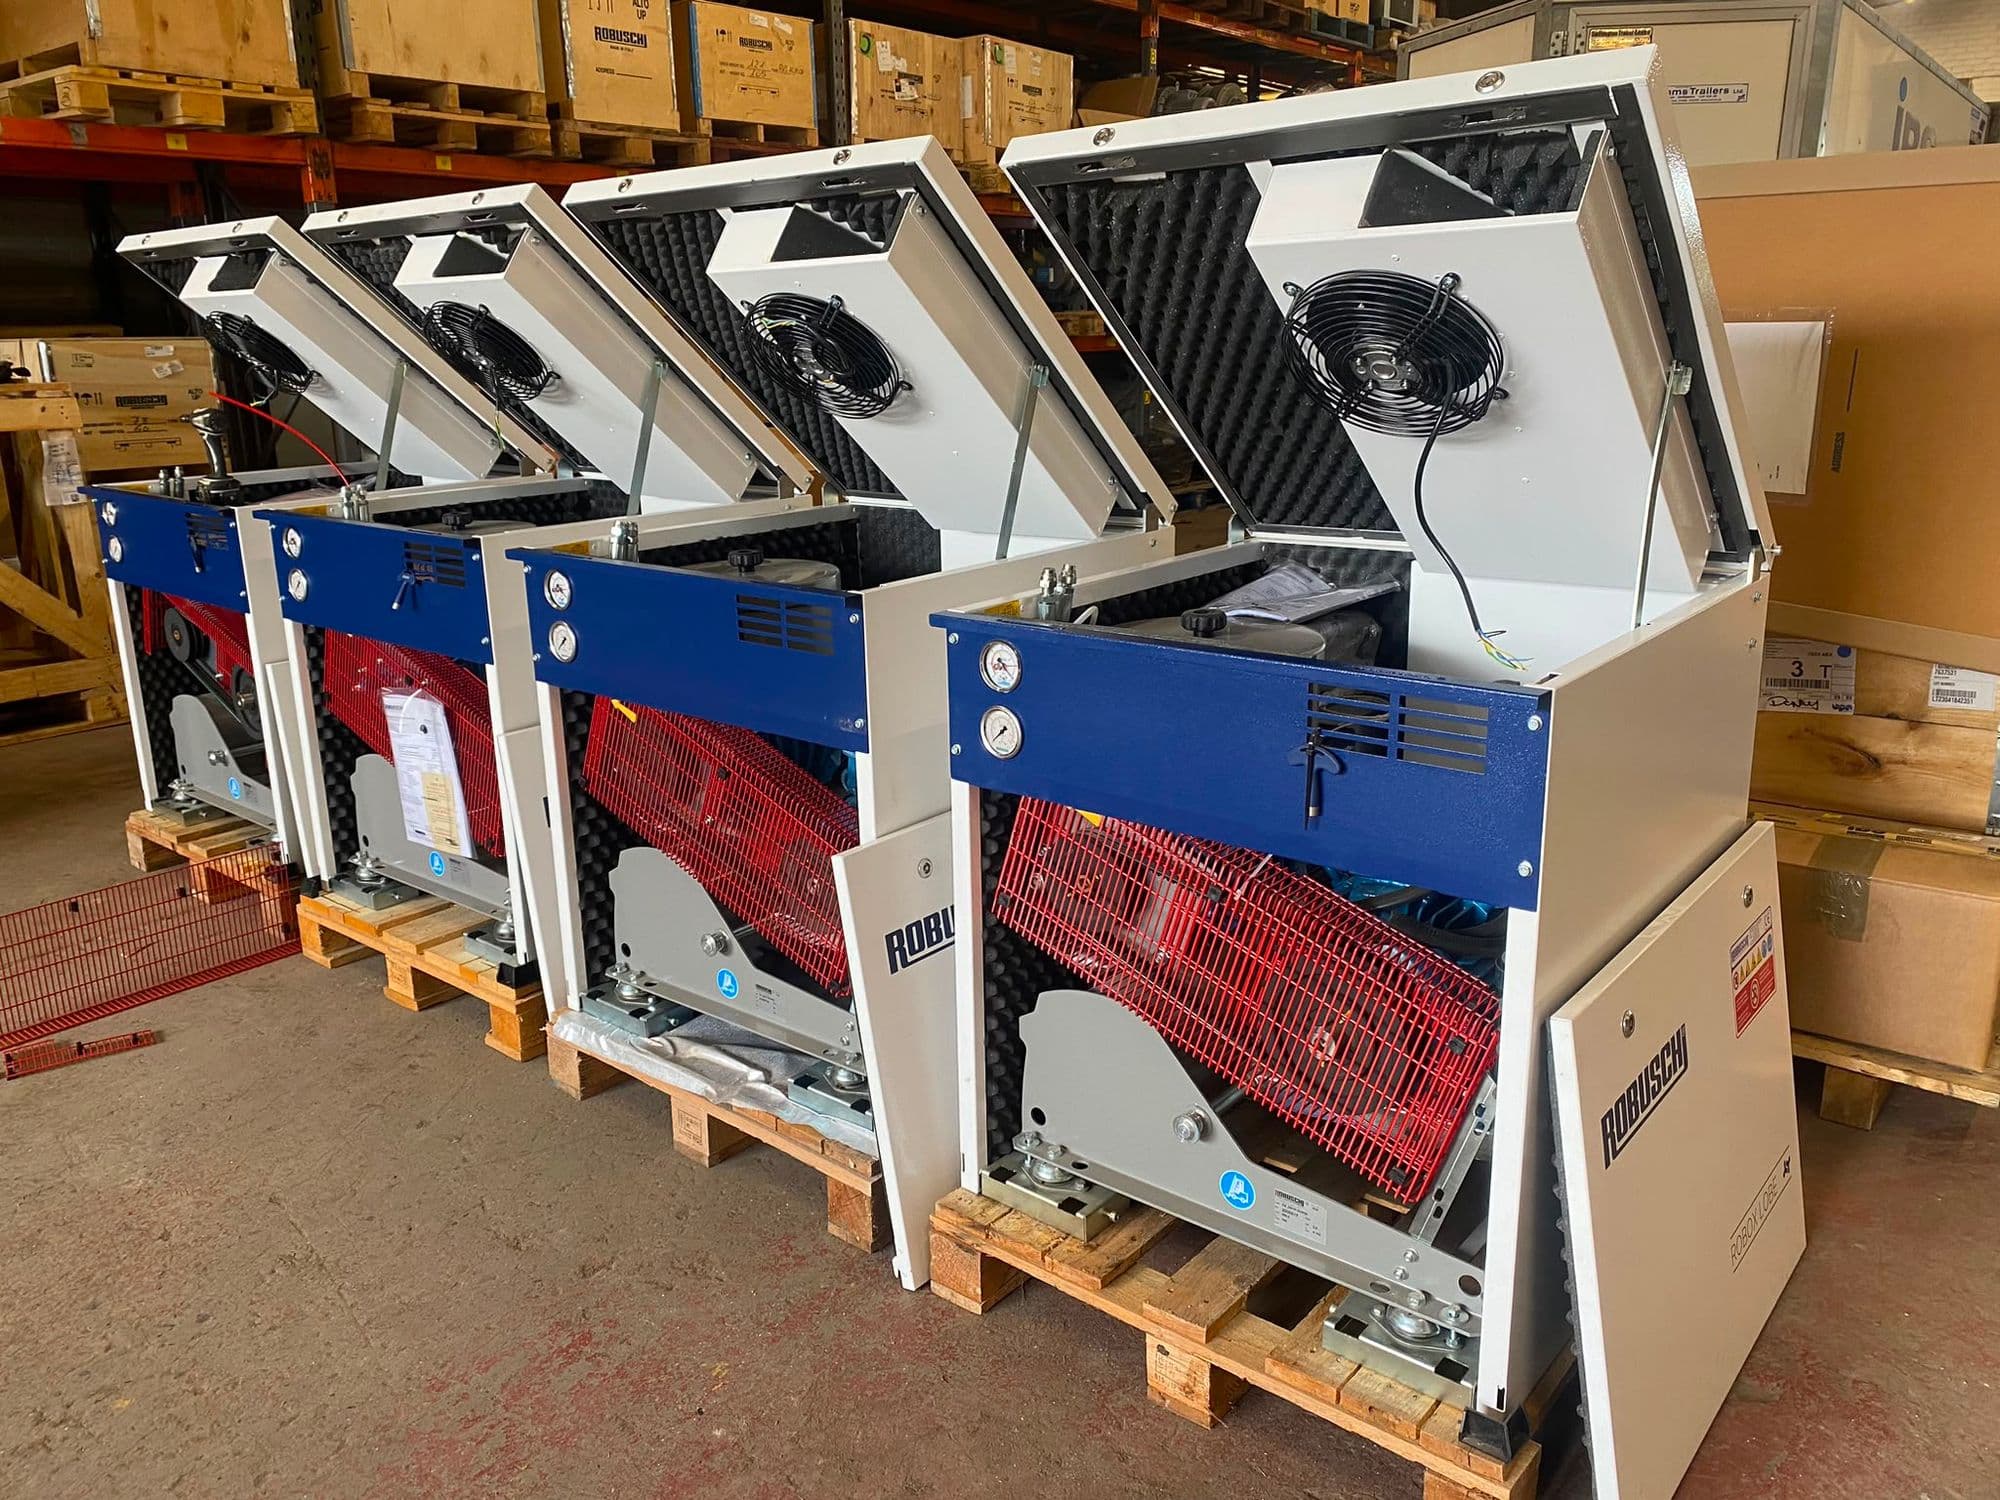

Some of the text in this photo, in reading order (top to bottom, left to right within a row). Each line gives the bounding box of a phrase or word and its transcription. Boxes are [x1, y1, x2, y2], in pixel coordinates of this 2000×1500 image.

[636, 9, 647, 20] UP
[594, 26, 648, 49] ROBUSCHI
[1690, 87, 1730, 95] Trailers
[1791, 660, 1832, 678] 3 T
[1600, 1023, 1689, 1170] ROBUSCHI
[1730, 1175, 1778, 1266] ROBOX LOBE
